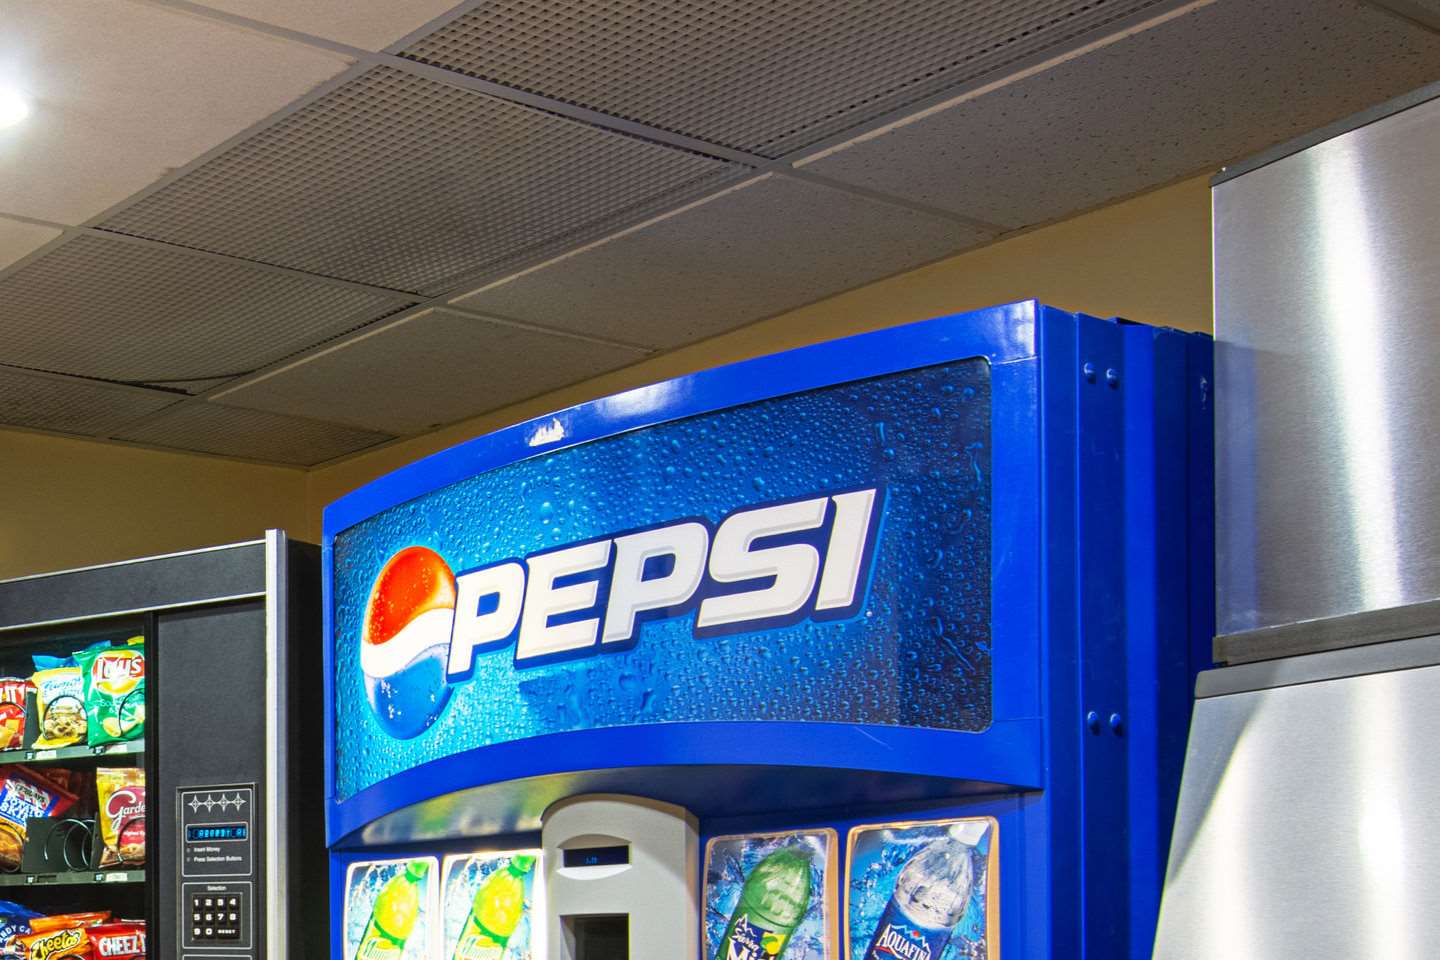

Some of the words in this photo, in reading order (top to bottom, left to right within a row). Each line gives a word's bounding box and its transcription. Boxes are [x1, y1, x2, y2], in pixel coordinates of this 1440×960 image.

[446, 488, 877, 676] PEPSI
[106, 790, 145, 832] Garde
[229, 898, 236, 906] 4
